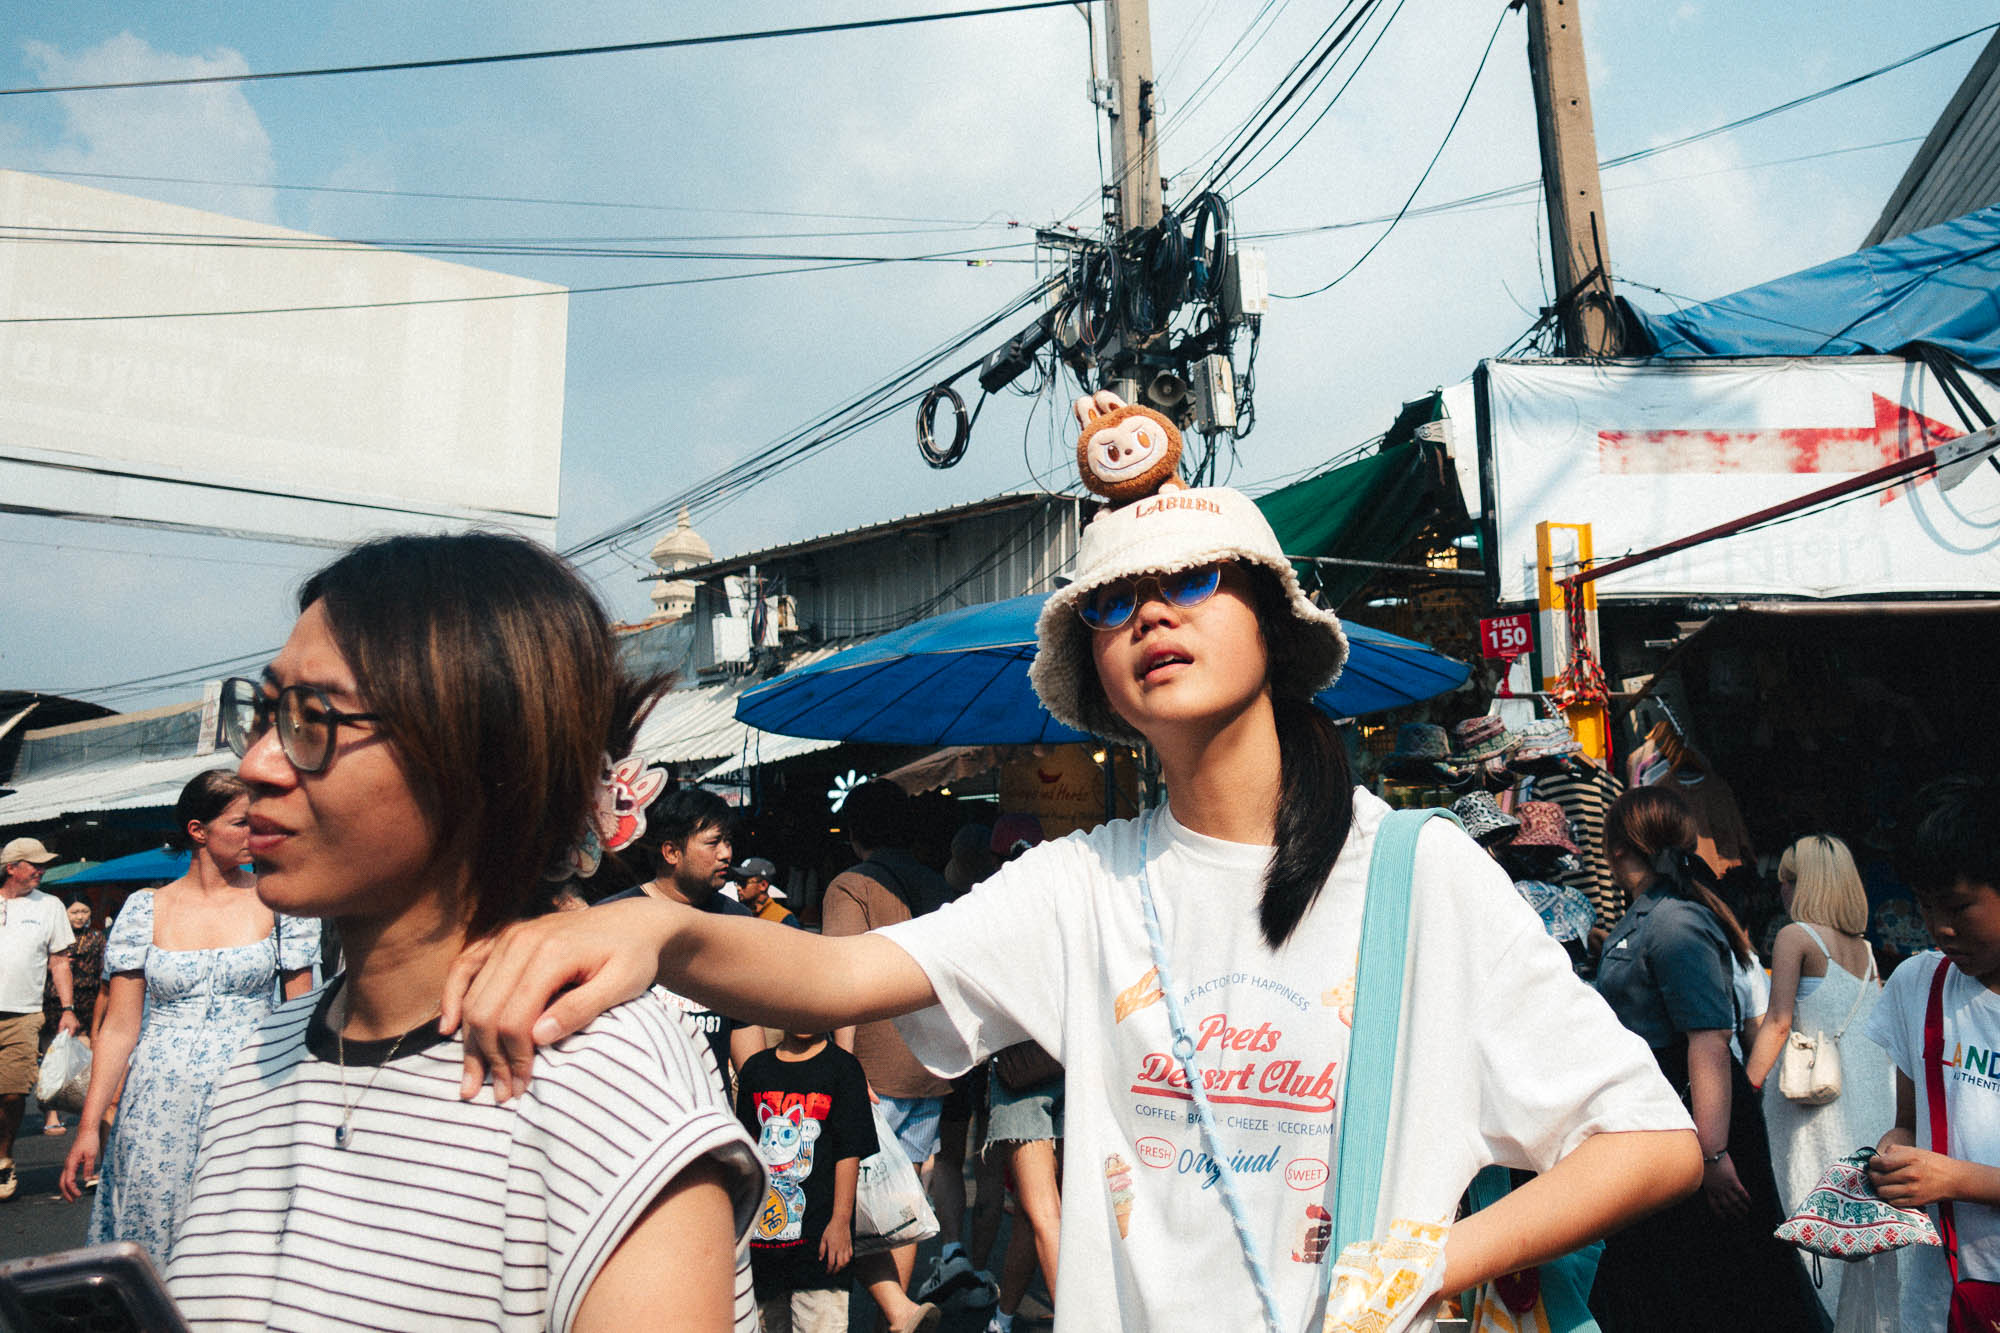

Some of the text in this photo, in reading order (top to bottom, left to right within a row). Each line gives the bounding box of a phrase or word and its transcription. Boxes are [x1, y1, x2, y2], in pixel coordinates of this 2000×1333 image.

[1136, 496, 1223, 518] LABUBU
[1492, 617, 1518, 629] SALE
[1489, 627, 1527, 649] 150
[1231, 972, 1248, 985] OF
[1251, 975, 1310, 1011] HAPPINESS
[1196, 1013, 1282, 1053] Peets
[1258, 1060, 1337, 1099] Club
[1135, 1104, 1176, 1121] COFFEE
[1227, 1115, 1269, 1131] CHEEZE
[1278, 1121, 1334, 1137] ICECREAM
[1140, 1145, 1171, 1160] FRESH
[1287, 1168, 1323, 1182] SWEET
